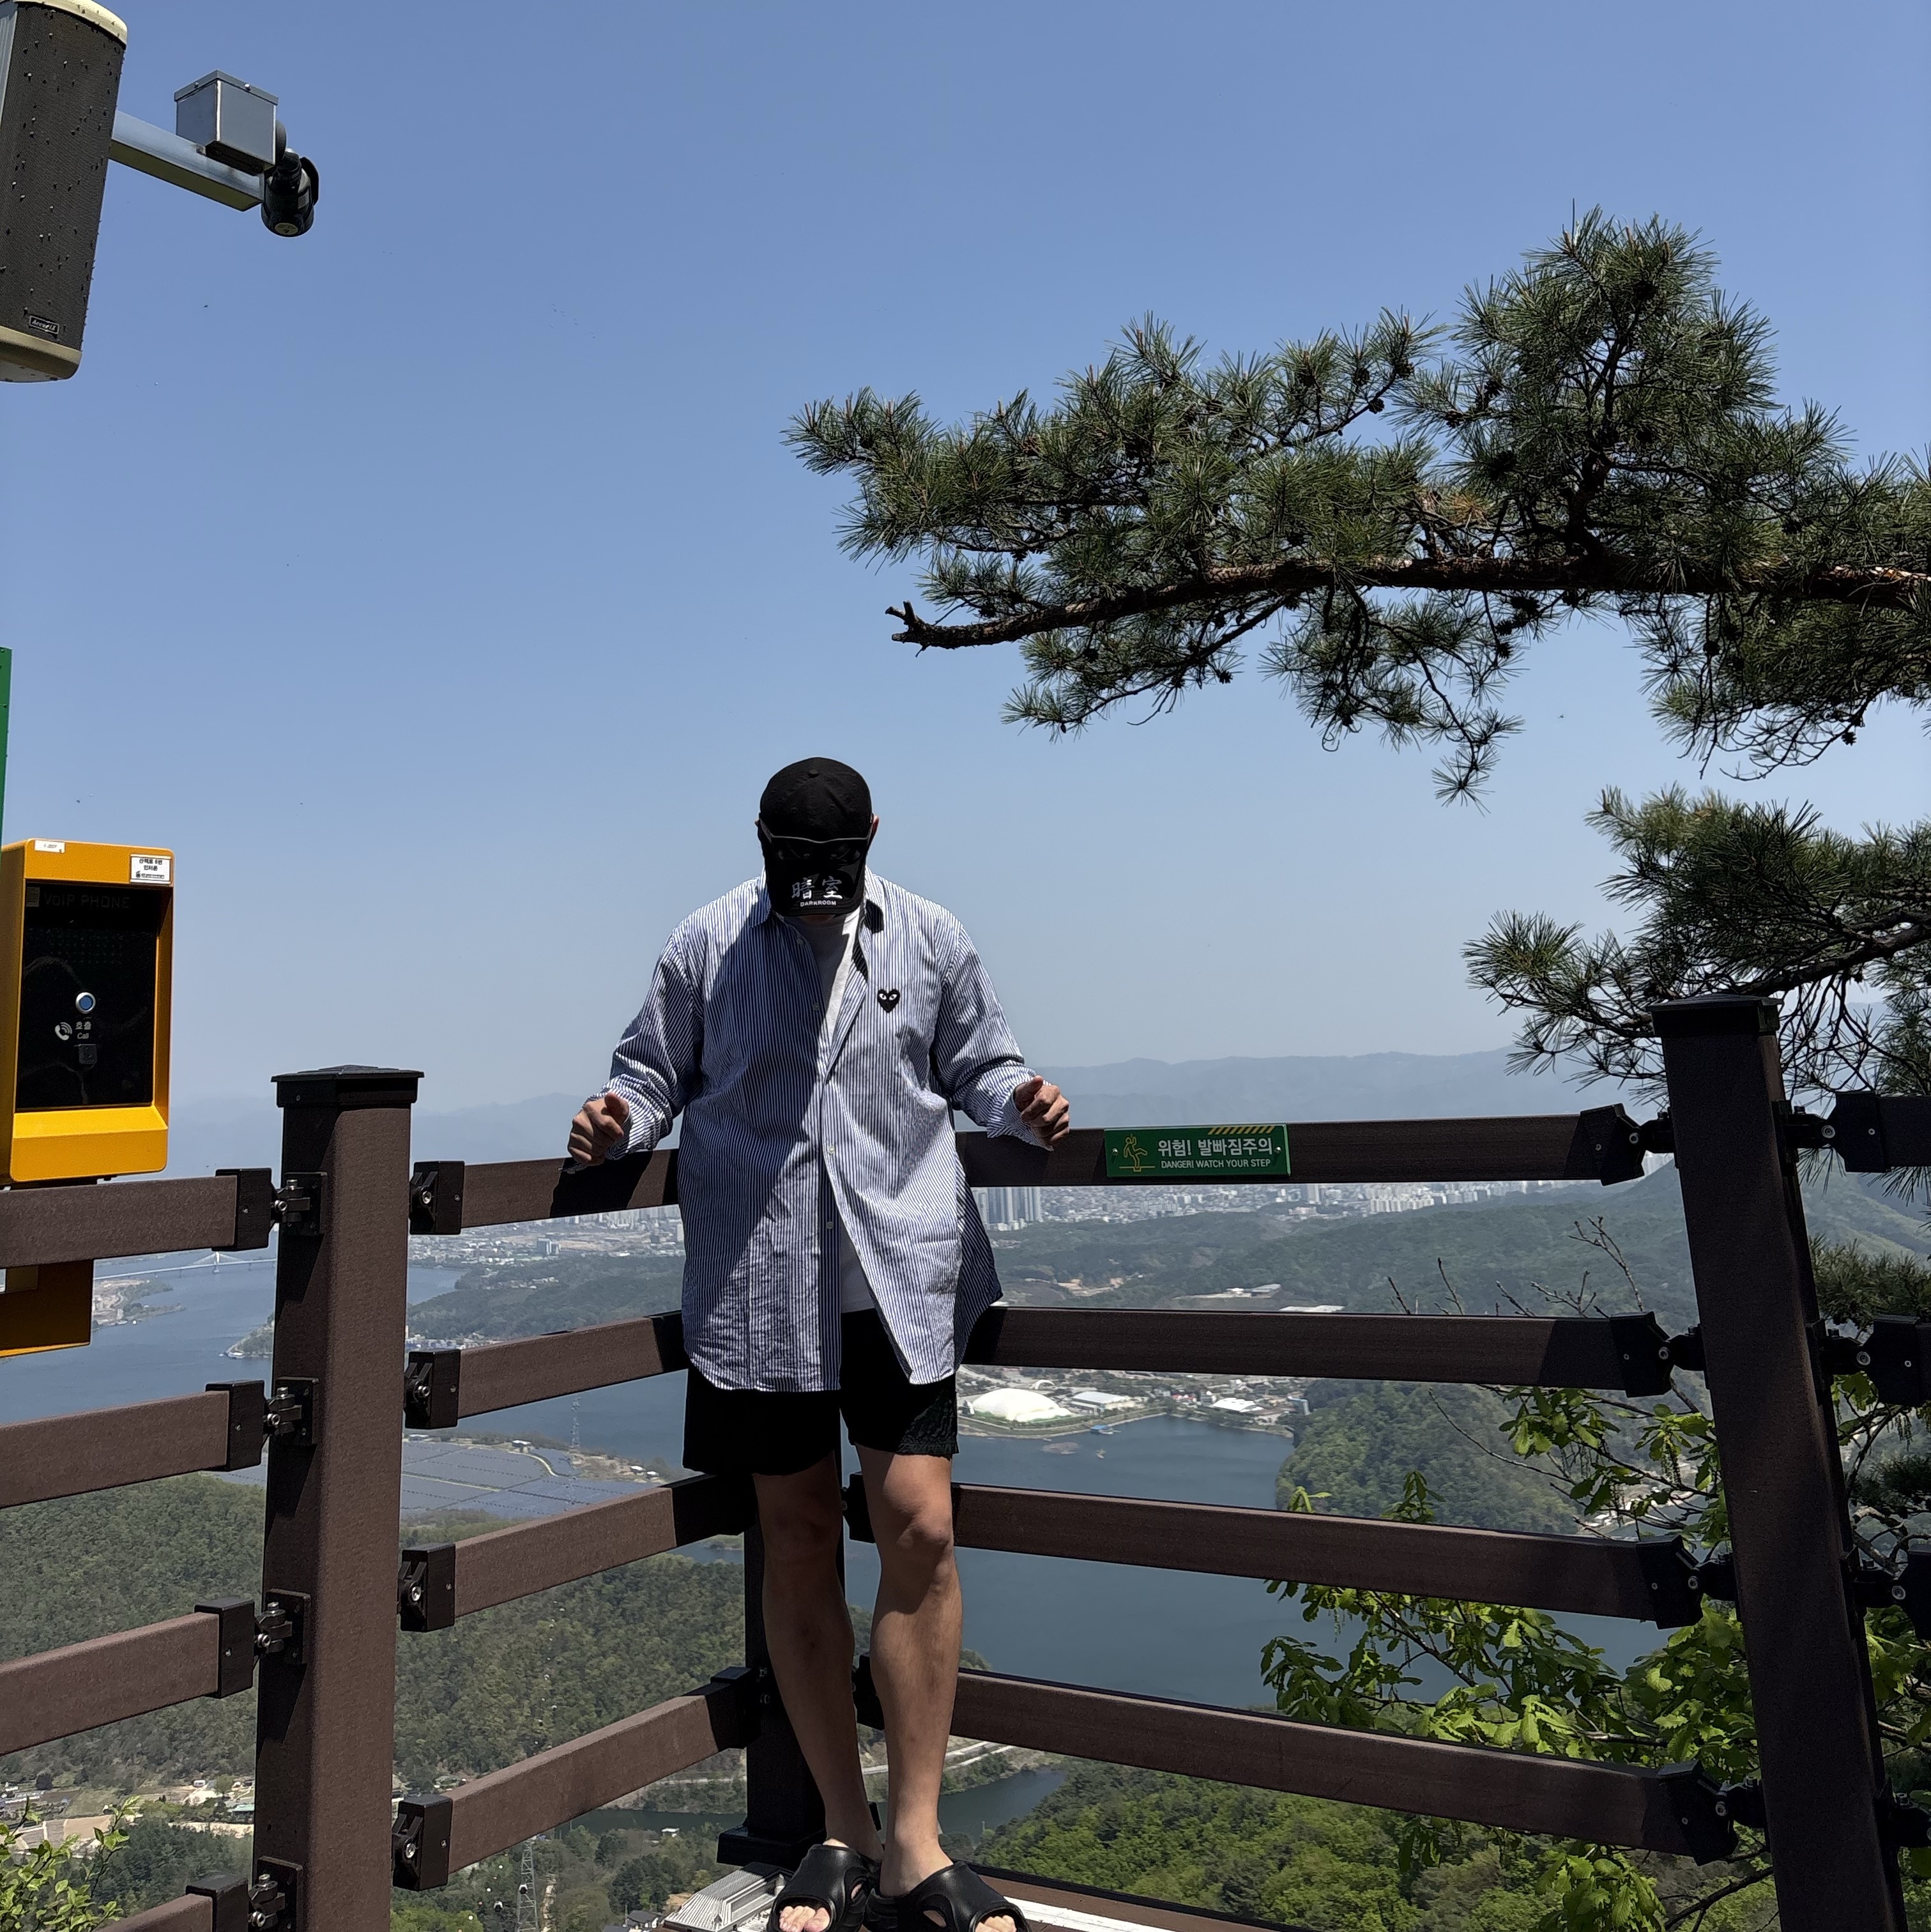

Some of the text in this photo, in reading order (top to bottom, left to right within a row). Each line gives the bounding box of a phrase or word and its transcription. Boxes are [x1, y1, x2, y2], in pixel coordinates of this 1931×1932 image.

[791, 876, 843, 900] 暗室
[80, 894, 130, 908] PHONE
[1157, 1137, 1273, 1156] 위험! 발빠짐주의
[1161, 1159, 1271, 1169] DANGER! WATCH YOUR STEP
